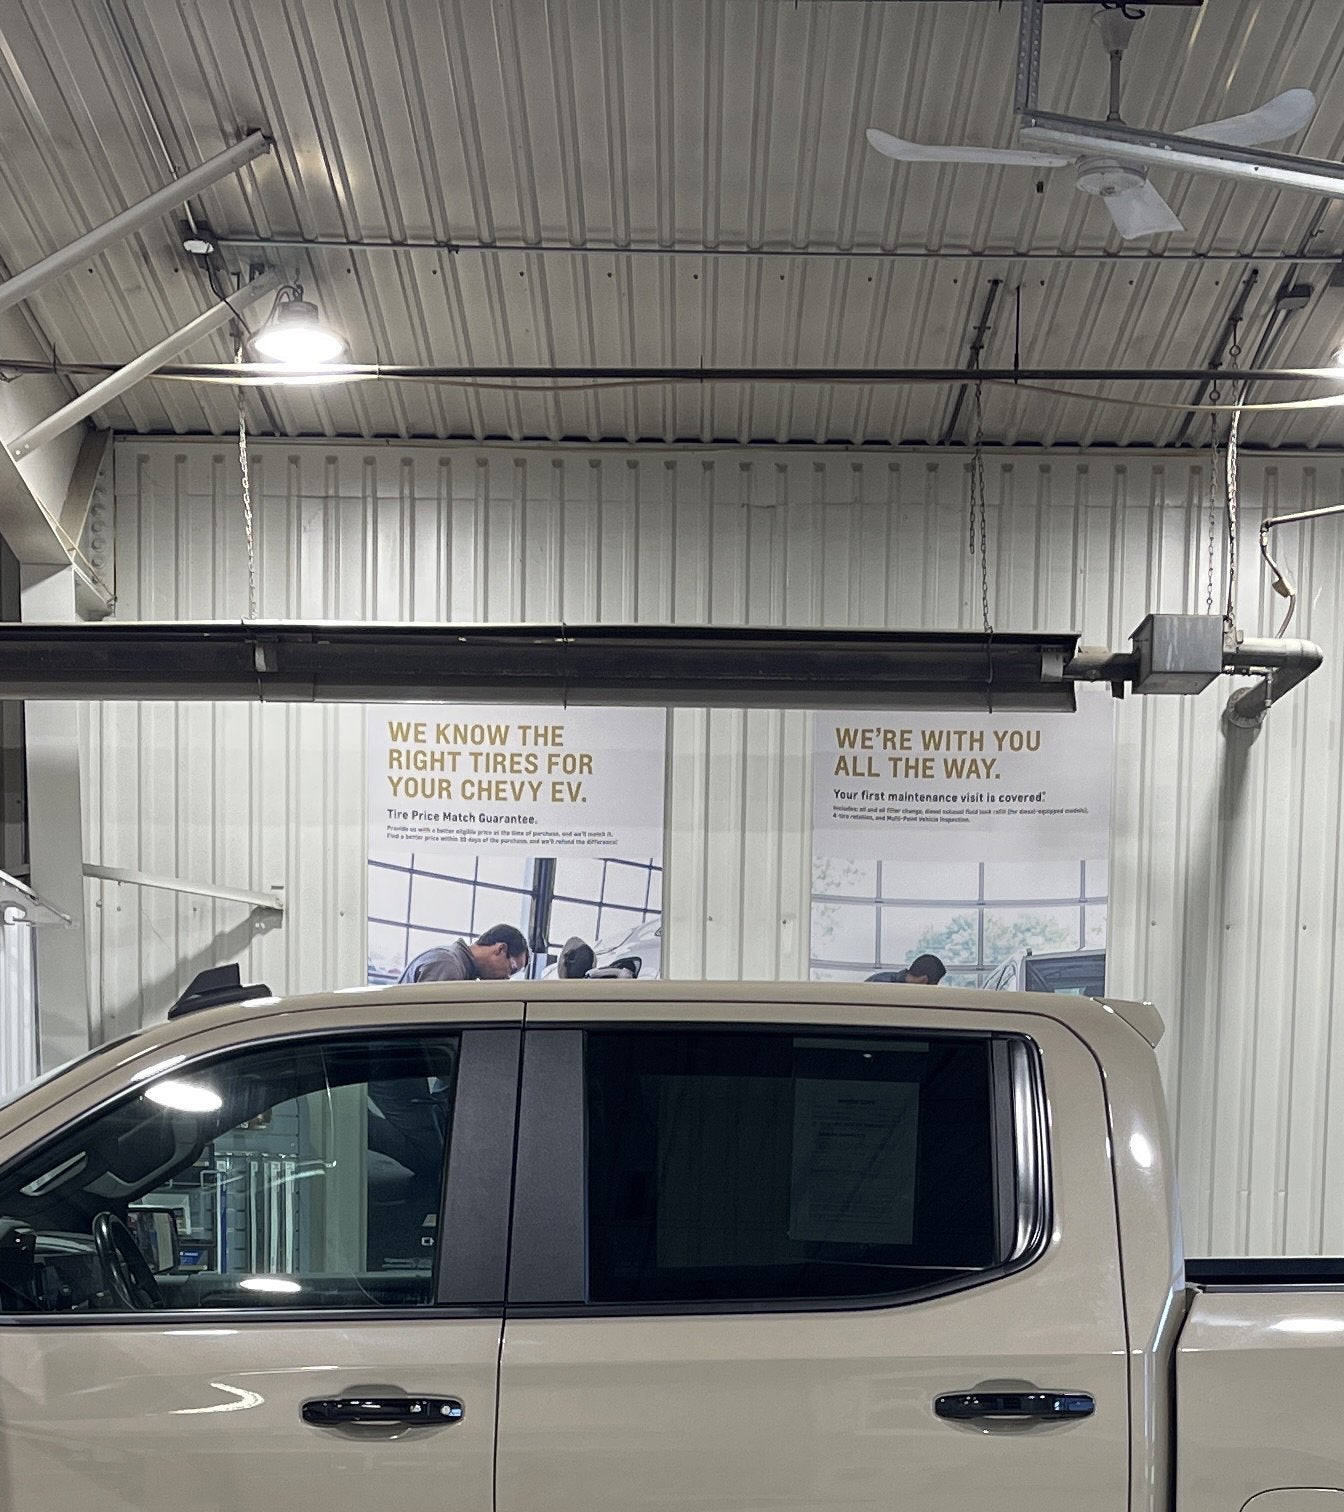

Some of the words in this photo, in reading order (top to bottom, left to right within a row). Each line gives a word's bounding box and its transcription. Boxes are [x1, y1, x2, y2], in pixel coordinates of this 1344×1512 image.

[388, 722, 426, 743] WE
[436, 723, 509, 745] KNOW
[518, 725, 565, 746] THE
[835, 728, 912, 750] WE'RE
[921, 730, 984, 751] WITH
[993, 730, 1041, 751] YOU
[389, 749, 461, 772] RIGHT
[469, 752, 538, 774] TIRES
[547, 753, 593, 775] FOR
[834, 755, 880, 777] ALL
[888, 757, 935, 779] THE
[943, 758, 1000, 779] WAY.
[388, 776, 452, 800] YOUR
[461, 779, 542, 801] CHEVY
[551, 781, 587, 802] EV.
[834, 790, 858, 800] Your
[861, 790, 885, 801] first
[888, 791, 958, 802] maintenance
[961, 792, 984, 803] visit
[987, 792, 995, 802] is
[388, 809, 408, 820] Tire
[412, 811, 439, 821] Price
[443, 812, 475, 823] Match
[479, 813, 538, 825] Guarantee.
